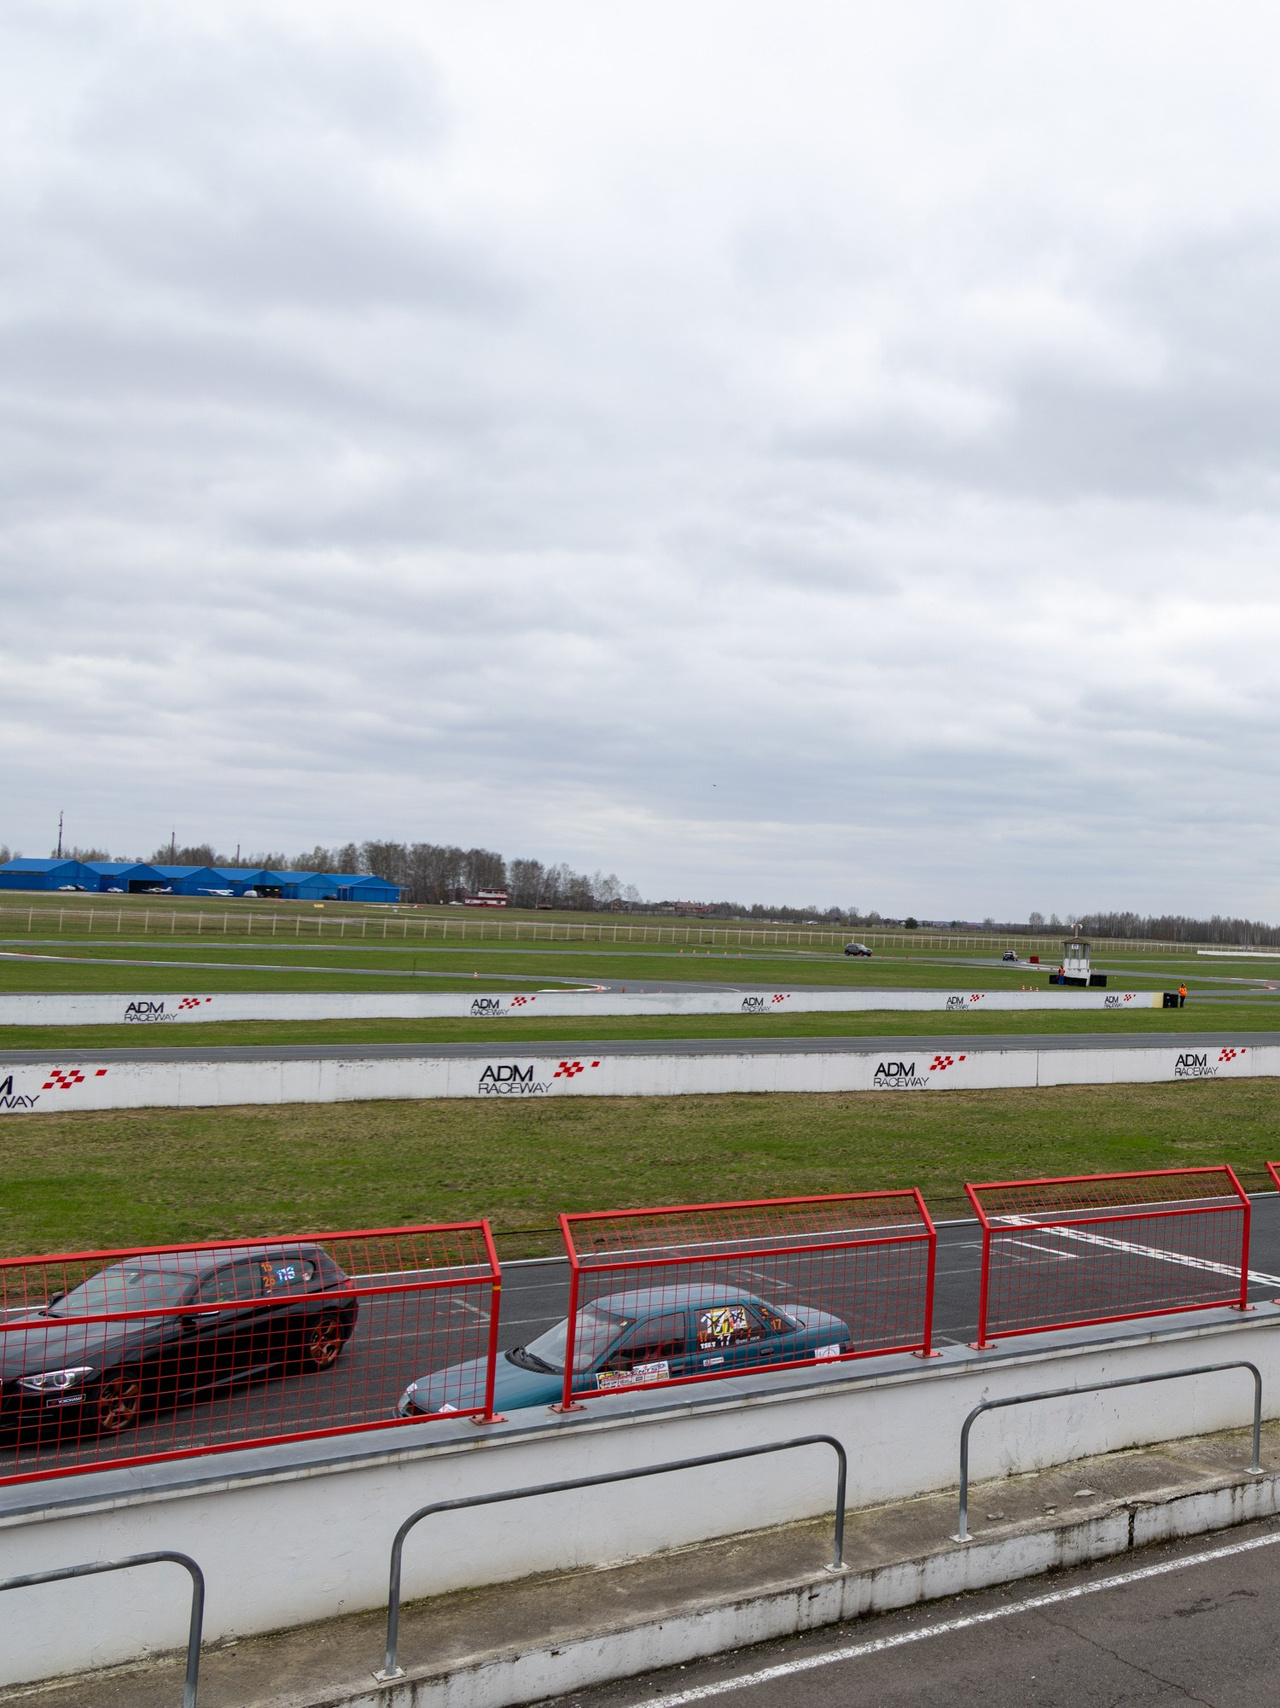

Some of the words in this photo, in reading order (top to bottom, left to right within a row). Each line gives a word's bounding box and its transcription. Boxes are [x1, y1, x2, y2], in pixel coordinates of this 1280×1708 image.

[471, 999, 500, 1008] ADM
[742, 997, 765, 1006] ADM
[947, 996, 964, 1004] ADM
[1104, 995, 1120, 1003] ADM
[125, 1002, 165, 1013] ADM
[124, 1013, 178, 1021] RACEWAY
[1175, 1054, 1208, 1067] ADM
[479, 1065, 535, 1082] ADM
[873, 1062, 916, 1077] ADM
[1174, 1067, 1219, 1076] RACEWAY
[873, 1077, 930, 1087] RACEWAY
[477, 1082, 553, 1095] RACEWAY
[771, 1318, 782, 1330] 17
